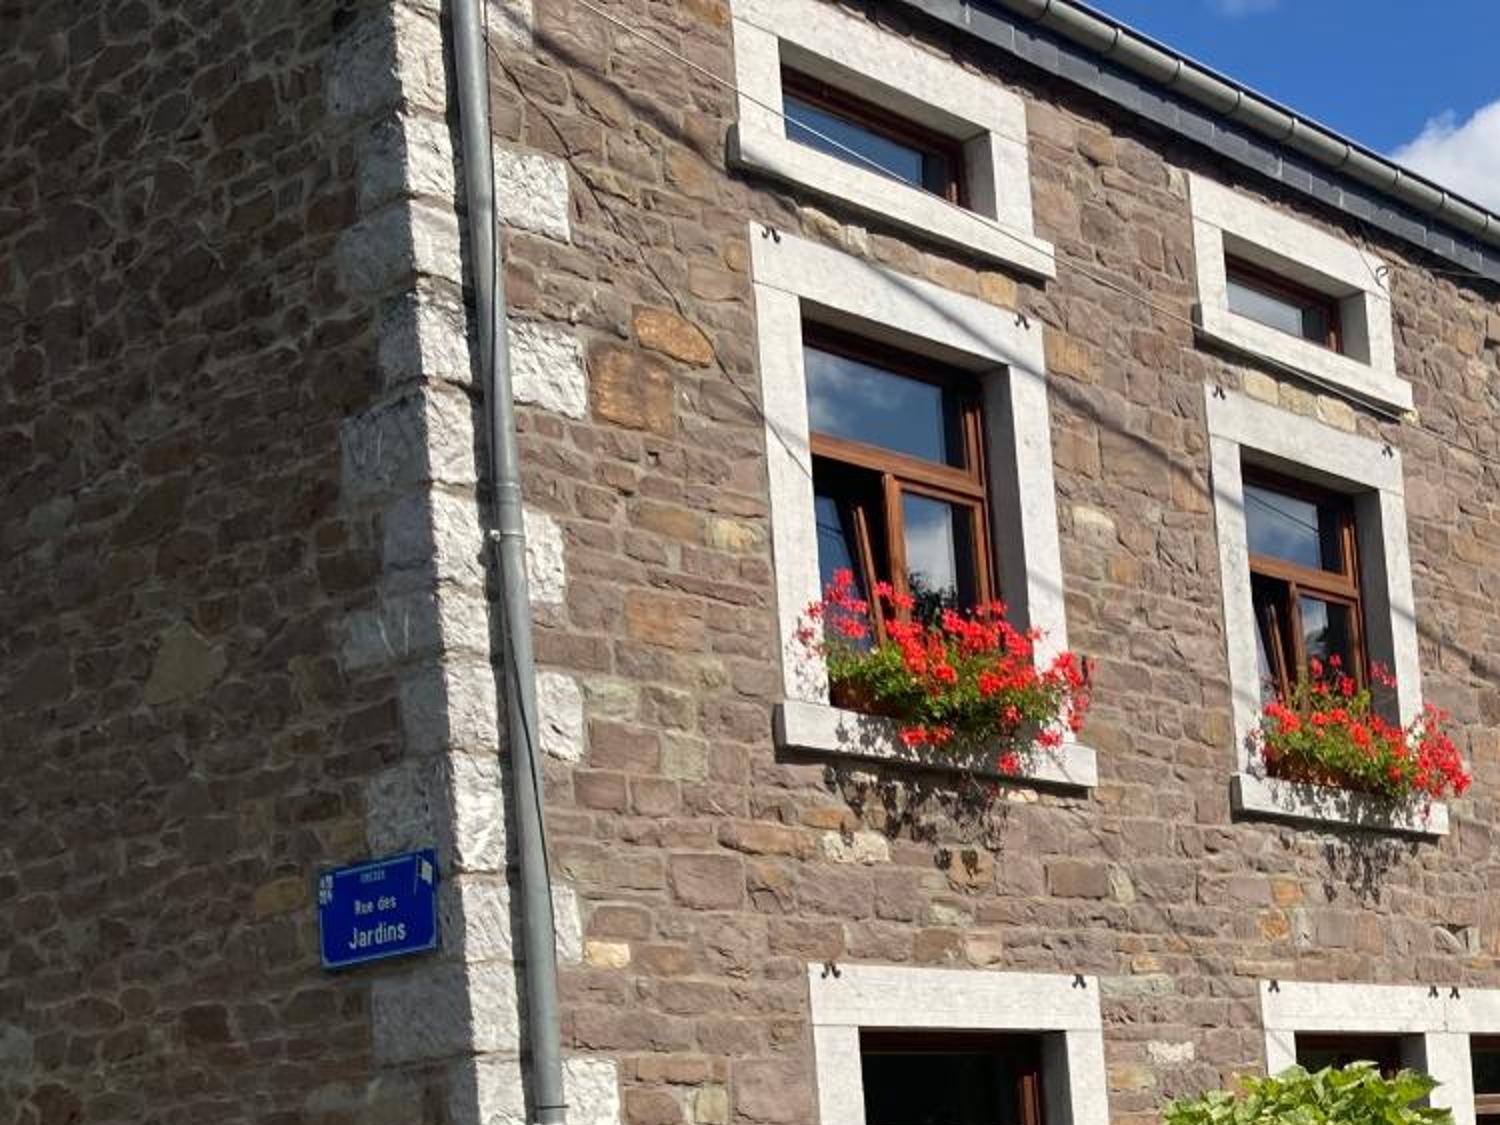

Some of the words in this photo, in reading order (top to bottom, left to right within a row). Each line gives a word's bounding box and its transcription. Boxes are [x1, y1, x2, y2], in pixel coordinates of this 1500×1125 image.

[354, 900, 374, 915] Rue
[377, 896, 397, 911] des
[348, 922, 407, 950] Jardins
